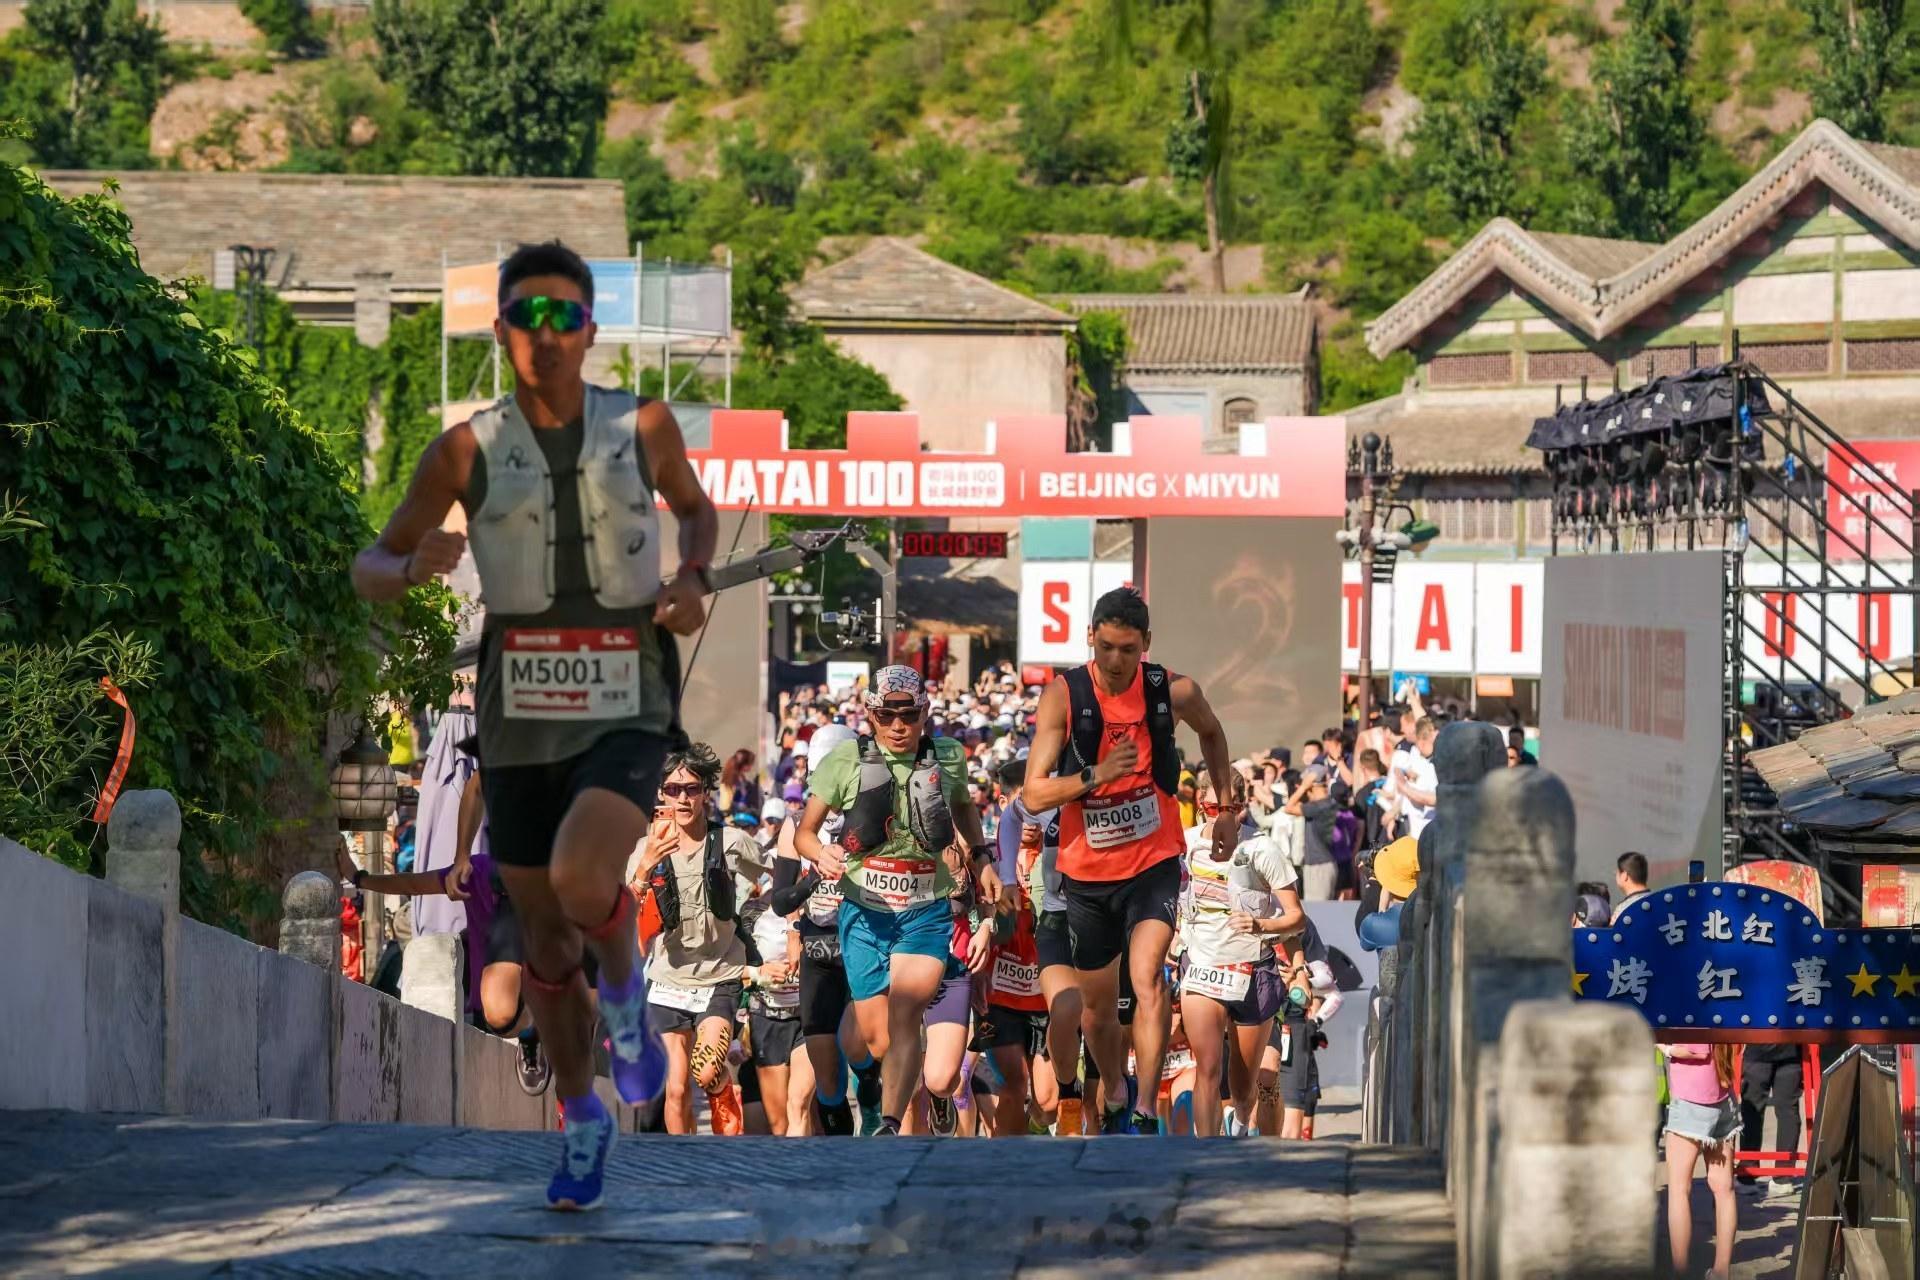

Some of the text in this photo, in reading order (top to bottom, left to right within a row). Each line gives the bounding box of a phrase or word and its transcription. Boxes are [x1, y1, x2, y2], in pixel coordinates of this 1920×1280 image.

[839, 459, 914, 507] 100
[1039, 471, 1157, 499] BEIJING
[1184, 471, 1281, 499] MIYUN
[1042, 581, 1070, 644] S
[511, 658, 604, 684] M5001
[1086, 804, 1142, 828] M5008
[866, 871, 919, 893] M5004
[1658, 909, 1775, 946] 古北红
[1605, 955, 1832, 1006] 烤红薯
